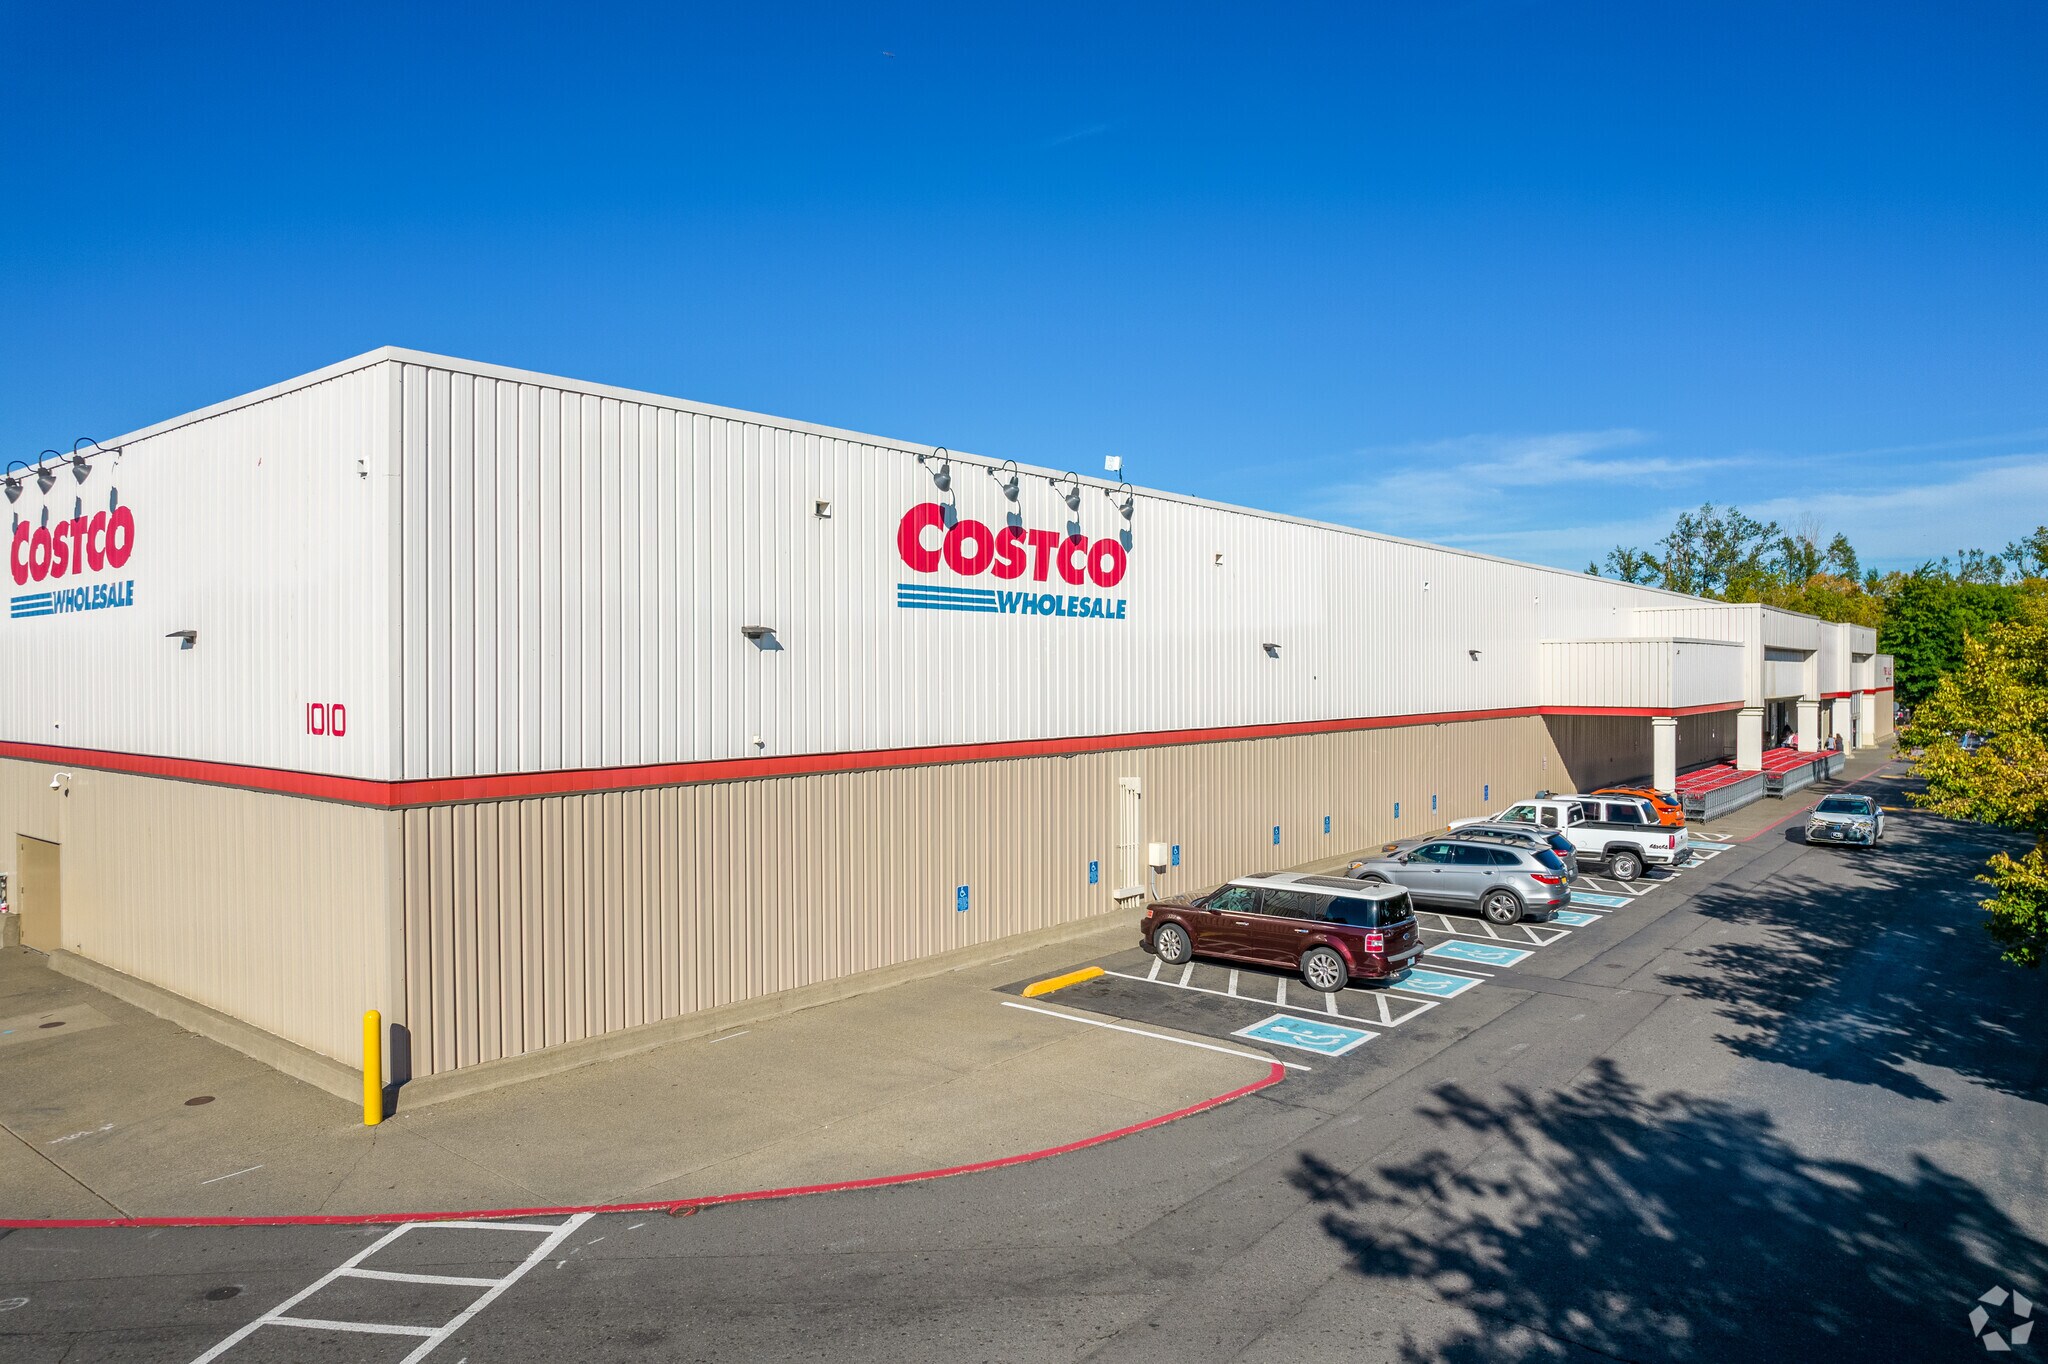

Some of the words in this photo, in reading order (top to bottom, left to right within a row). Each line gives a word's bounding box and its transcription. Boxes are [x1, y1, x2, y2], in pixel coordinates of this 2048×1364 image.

[11, 505, 135, 586] COSTCO
[897, 502, 1127, 588] COSTCO
[53, 580, 134, 614] WHOLESALE
[996, 590, 1127, 620] WHOLESALE
[306, 702, 346, 737] 1010
